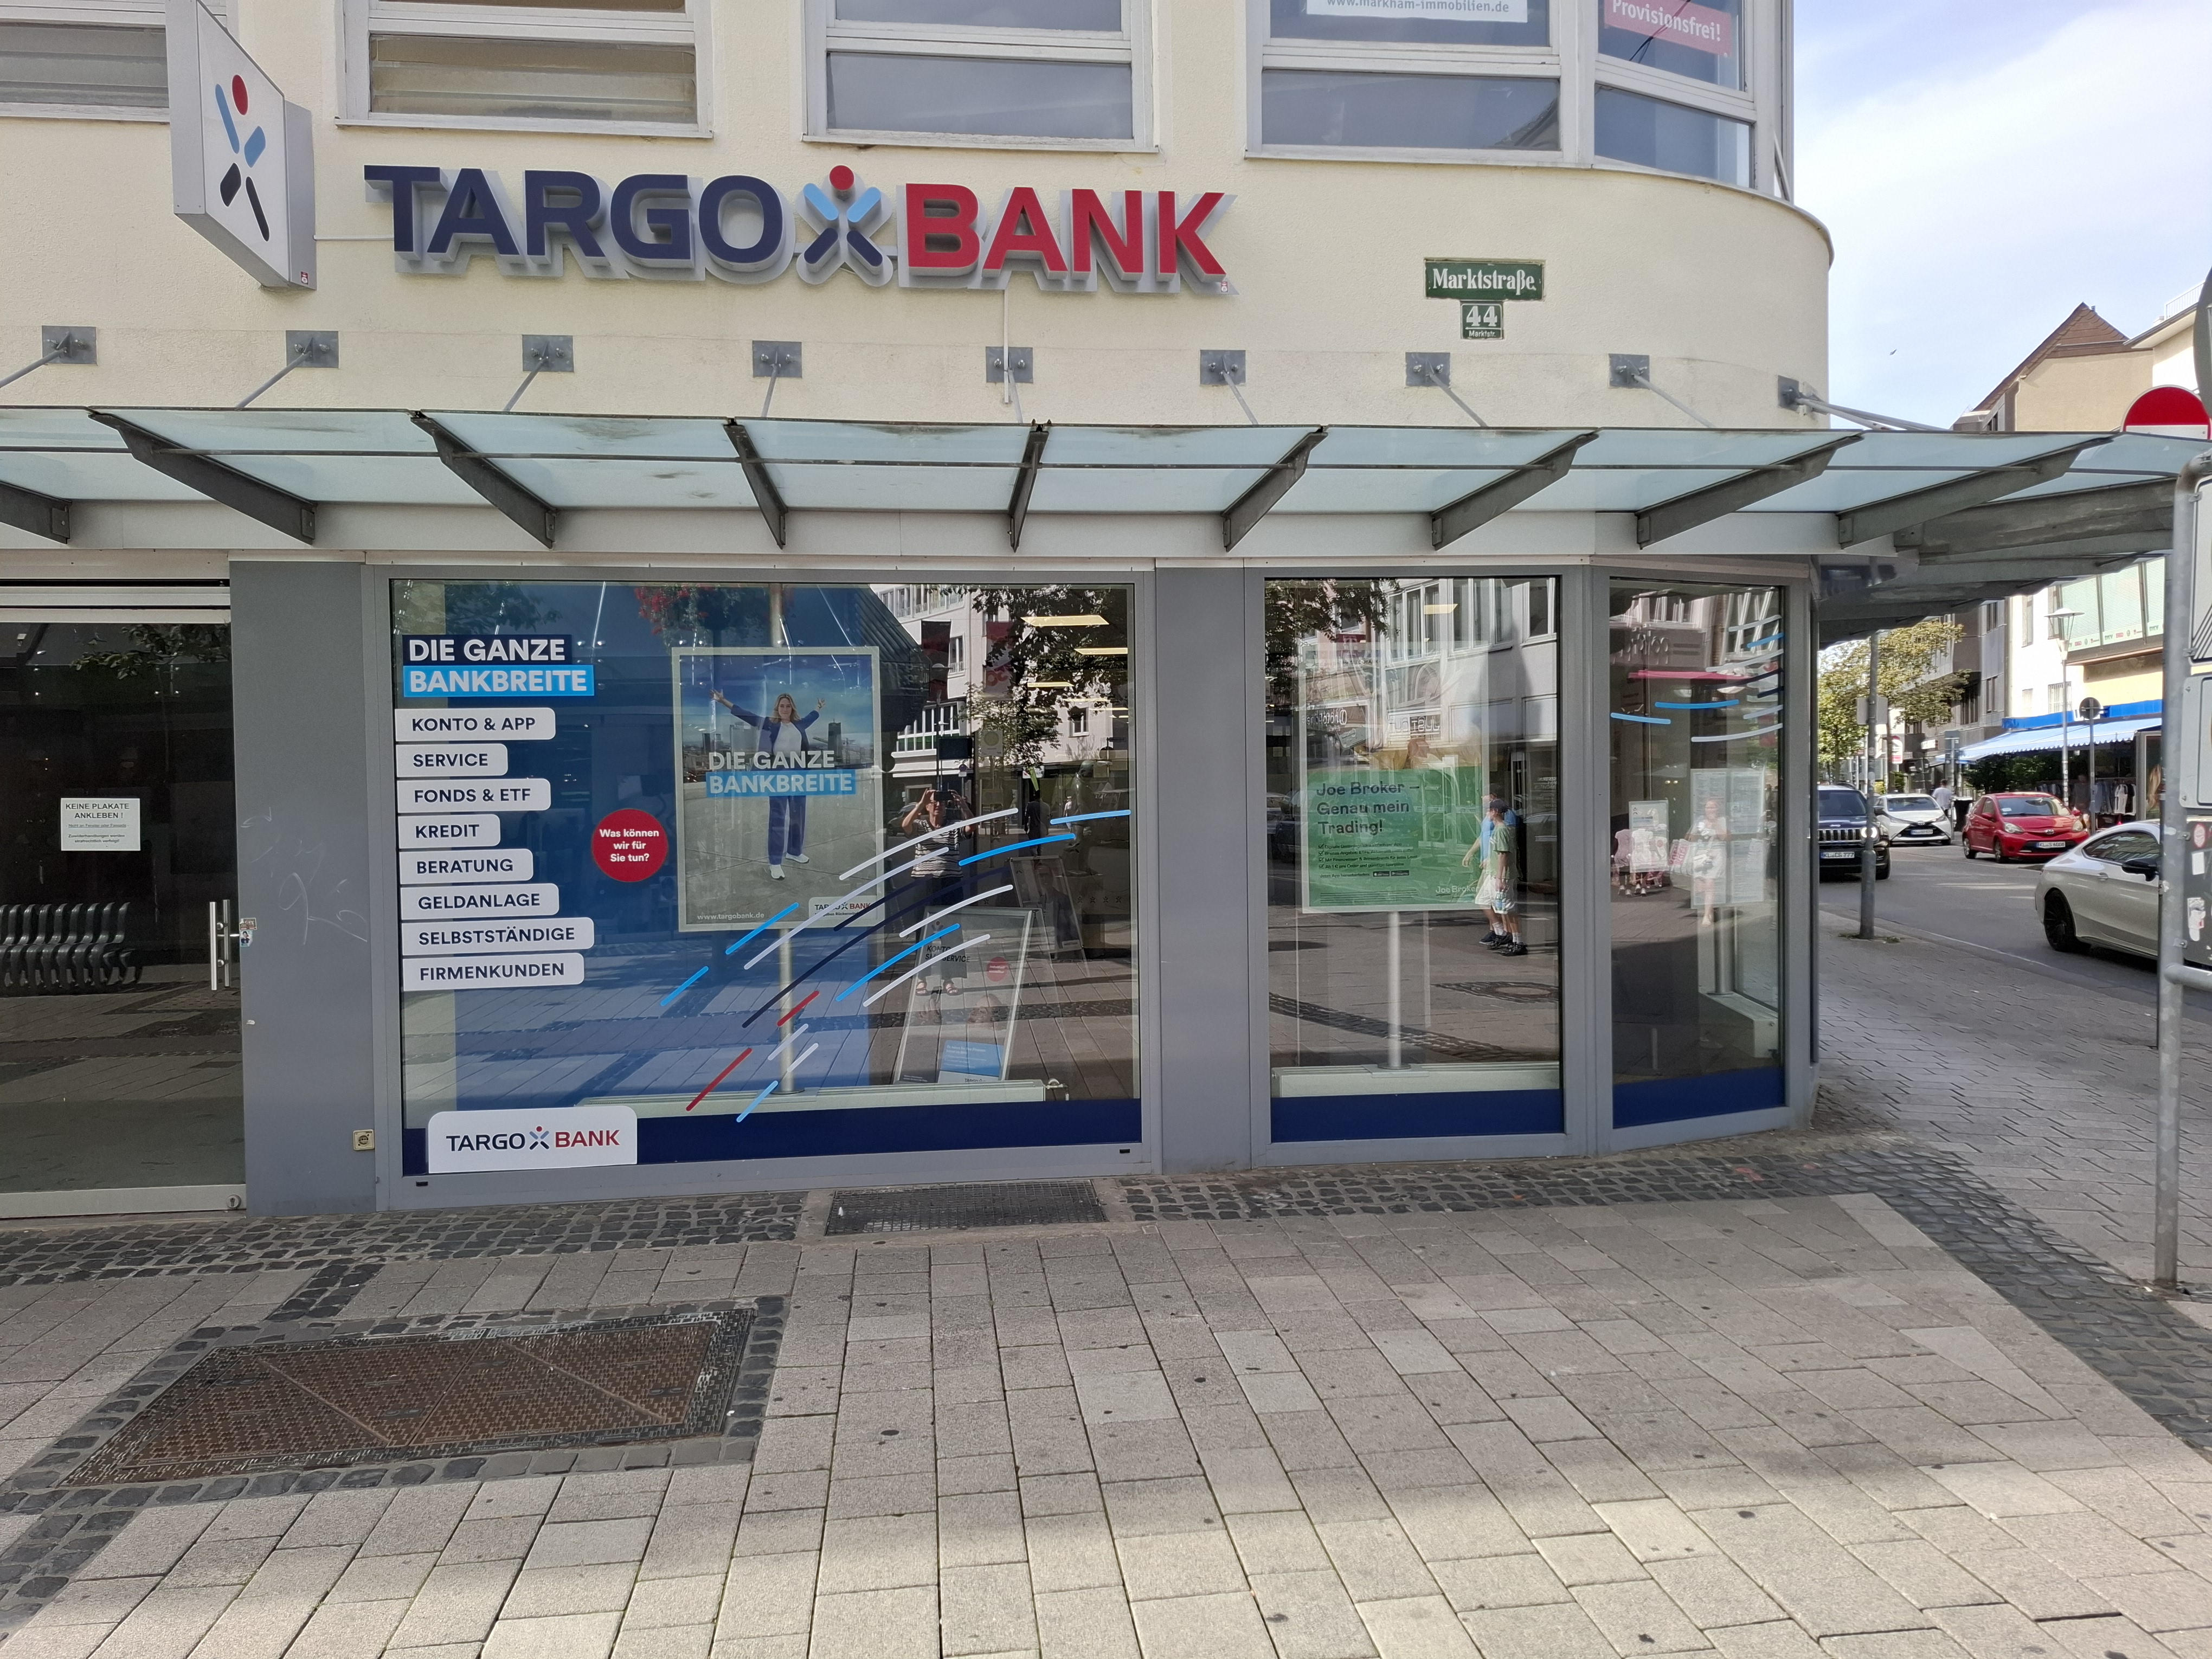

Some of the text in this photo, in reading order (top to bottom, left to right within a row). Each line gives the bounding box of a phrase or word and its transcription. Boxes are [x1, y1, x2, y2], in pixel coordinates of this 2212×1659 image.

[1612, 0, 1721, 42] Provisionsfrei!
[1432, 268, 1537, 295] Marktstraße
[1466, 305, 1497, 326] 44
[409, 639, 565, 661] DIE GANZE
[410, 670, 587, 692] BANKBREITE
[412, 717, 536, 731] KONTO & APP
[413, 753, 488, 767] SERVICE
[709, 750, 835, 770] DIE GANZE
[709, 773, 852, 794] BANKBREITE
[1316, 783, 1346, 796] Joe
[1351, 781, 1405, 795] Broker
[414, 788, 531, 803] FONDS & ETF
[1316, 800, 1410, 815] Genau mein
[415, 824, 480, 838] KREDIT
[600, 828, 660, 838] Was können
[1317, 819, 1382, 835] Trading!
[613, 841, 647, 850] wir für
[610, 853, 650, 862] Sie tun?
[416, 858, 513, 874] BERATUNG
[1451, 885, 1479, 893] Broker
[418, 893, 540, 910] GELDANLAGE
[697, 912, 765, 921] www.targobank.de
[419, 925, 575, 946] SELBSTSTÄNDIGE
[420, 962, 564, 981] FIRMENKUNDEN
[446, 1129, 620, 1152] TARGO BANK
